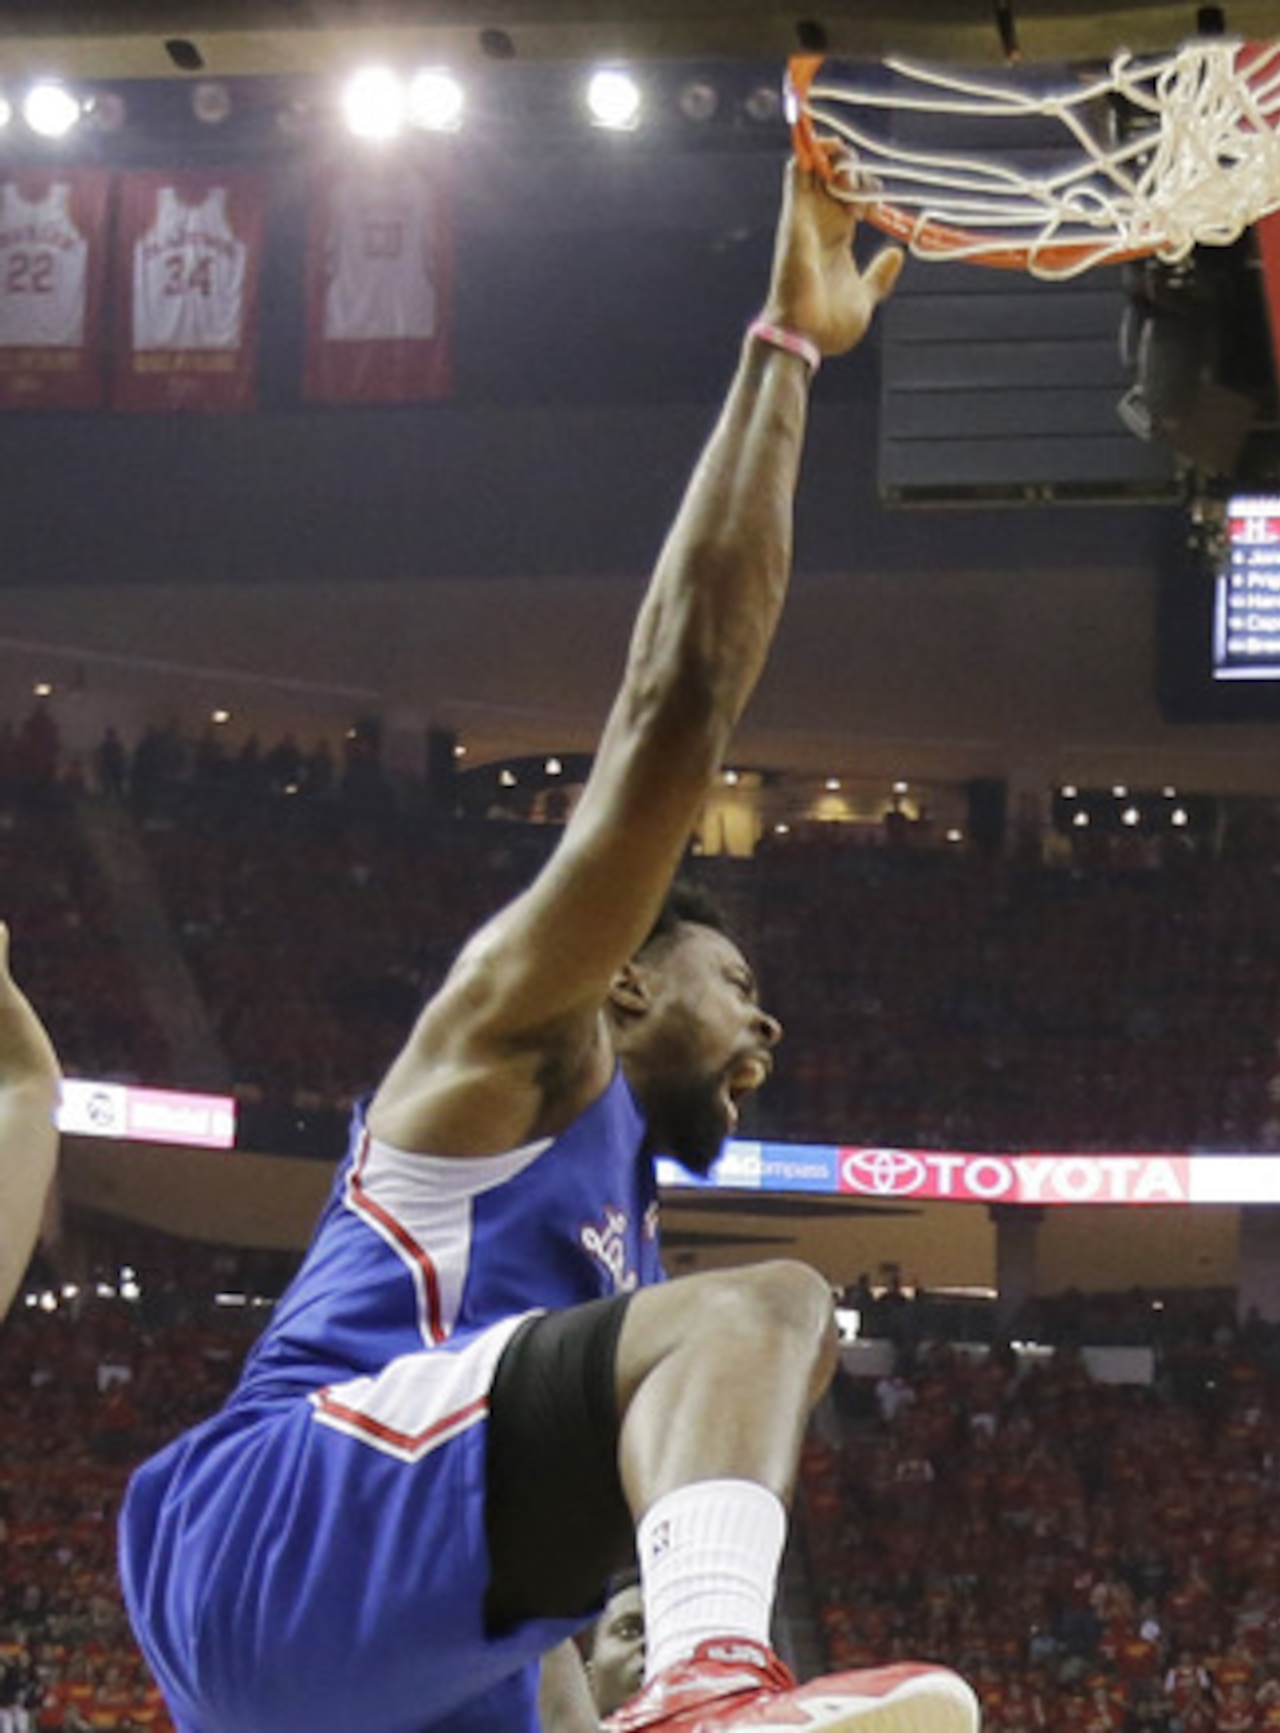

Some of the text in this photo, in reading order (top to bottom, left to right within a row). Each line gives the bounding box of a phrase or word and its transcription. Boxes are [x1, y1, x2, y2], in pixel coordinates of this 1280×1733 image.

[6, 252, 54, 294] 22
[162, 255, 214, 298] 34
[924, 1157, 1188, 1201] TOYOTA
